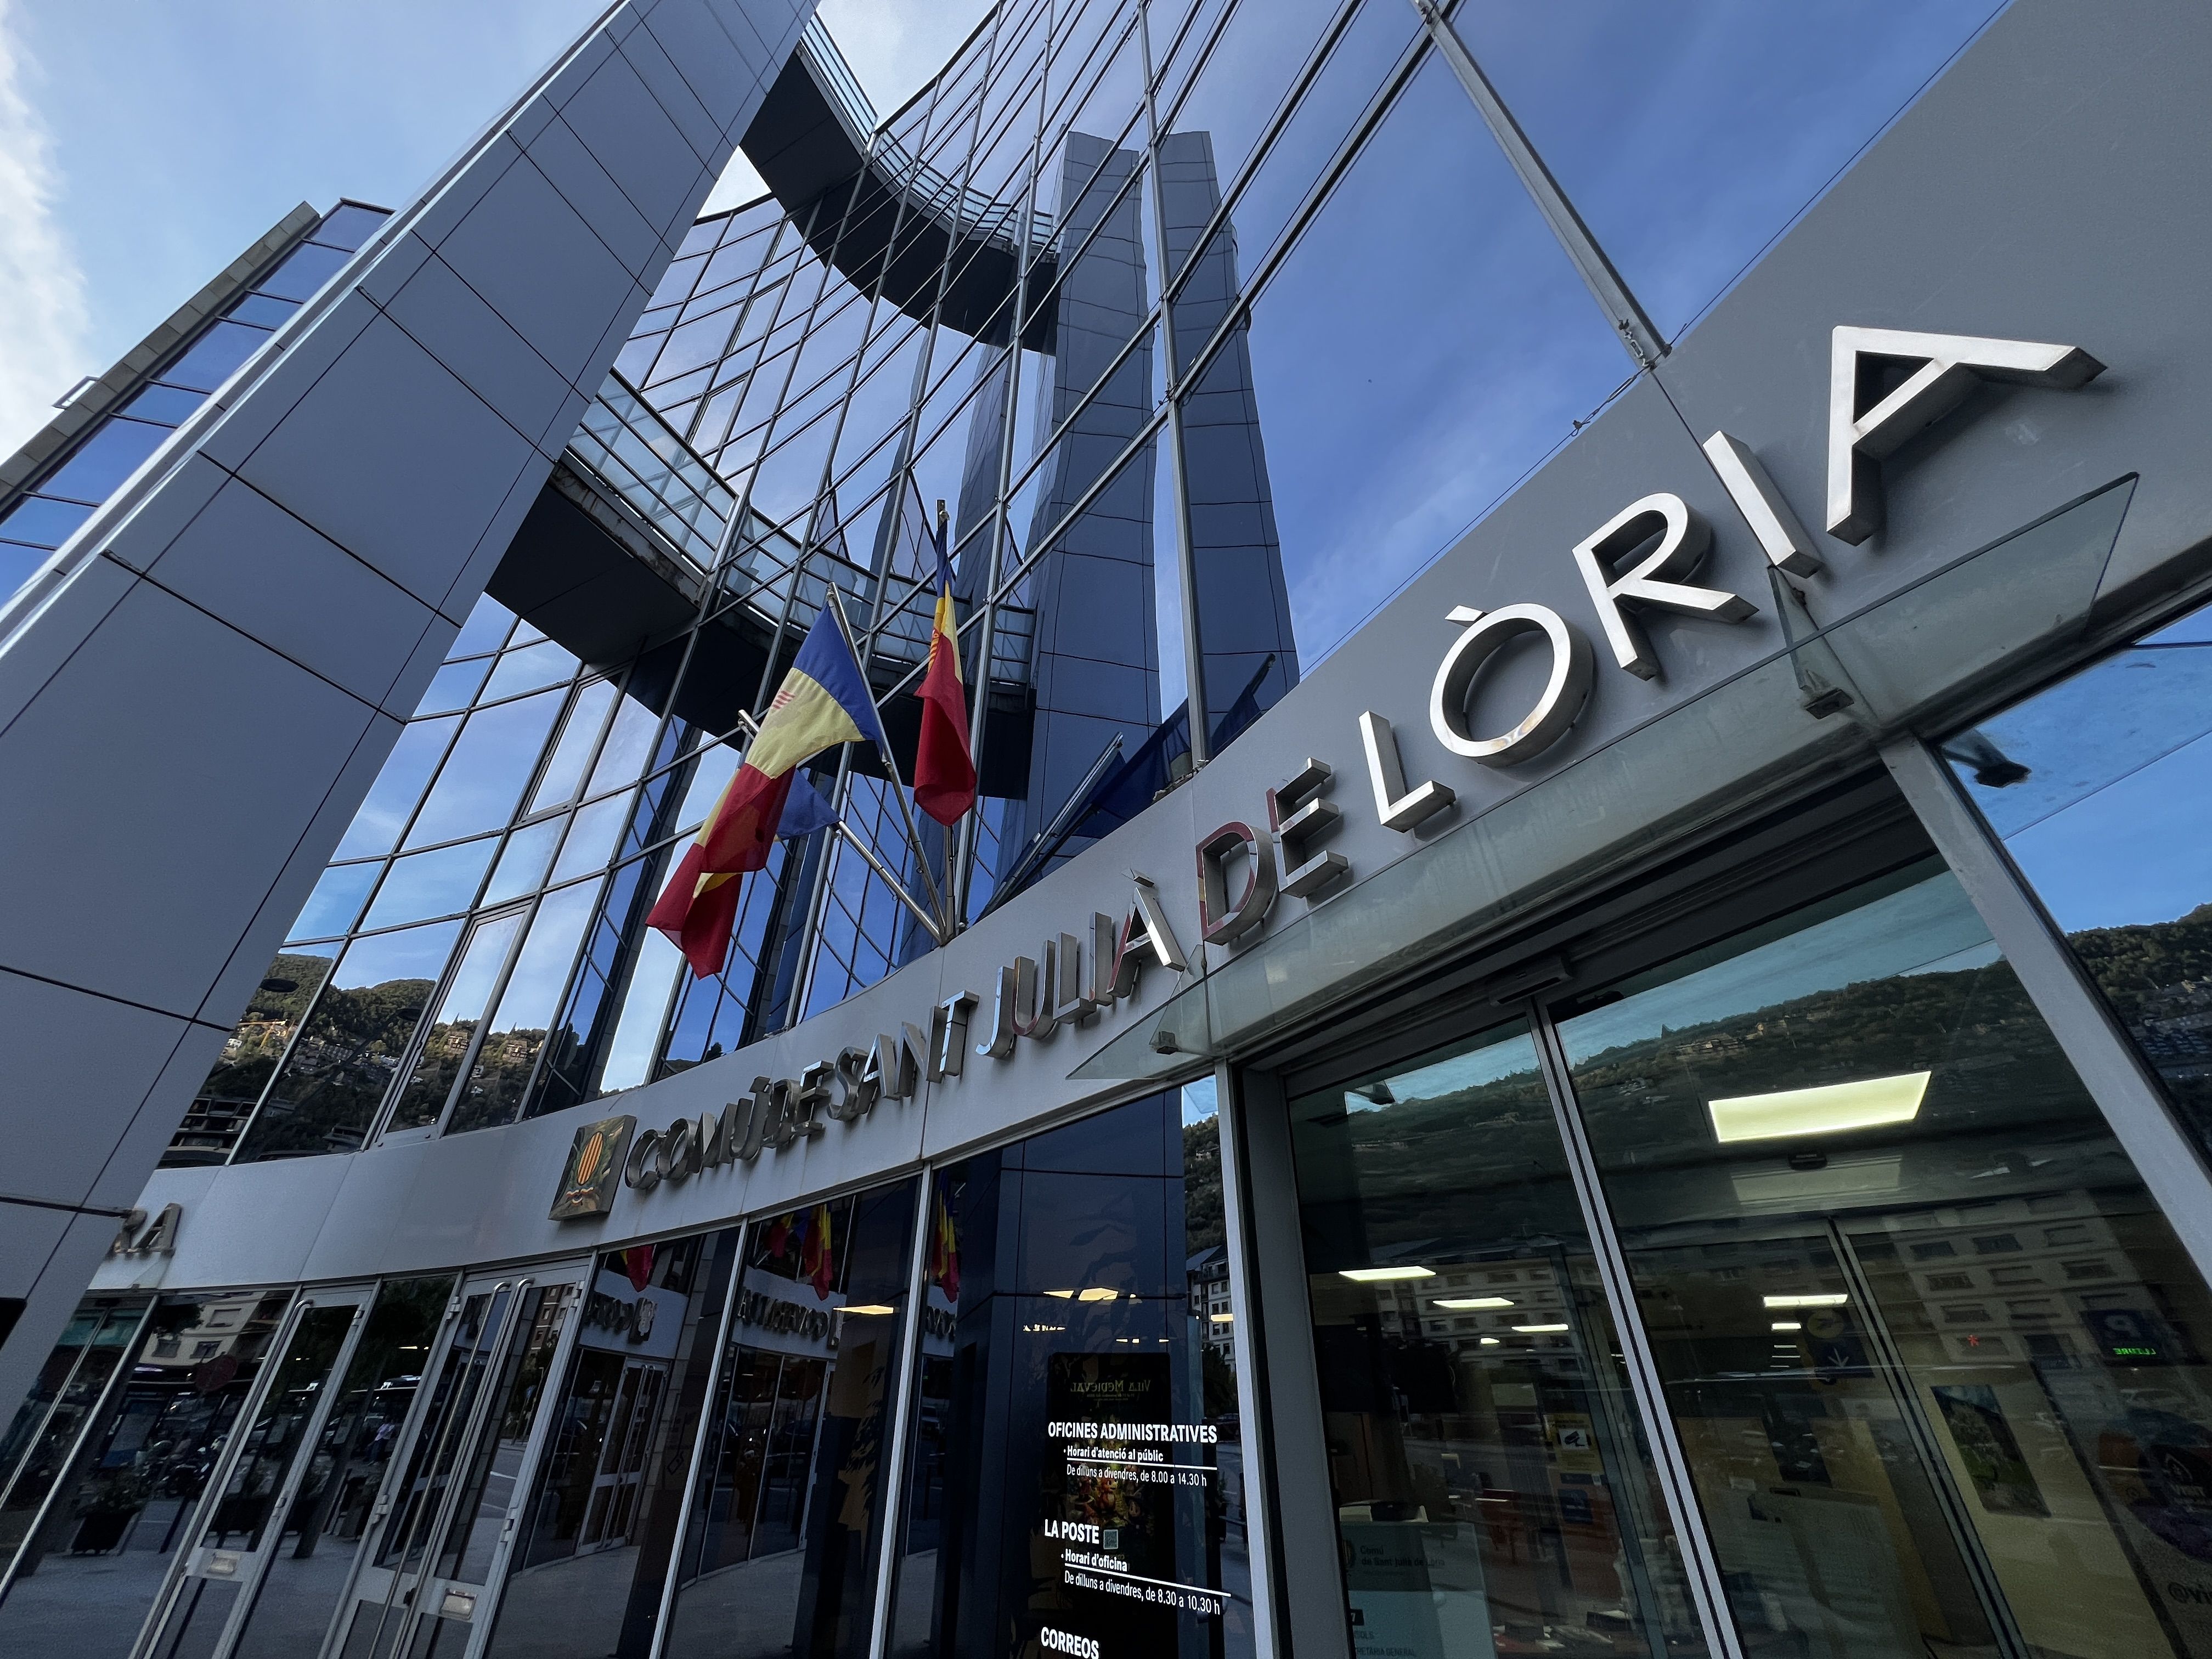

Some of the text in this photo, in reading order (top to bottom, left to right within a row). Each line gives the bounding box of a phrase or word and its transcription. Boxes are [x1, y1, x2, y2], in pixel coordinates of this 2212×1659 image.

[624, 325, 2109, 1189] COMÚ DE SANT JULIÀ DE LÒRIA
[1048, 1421, 1217, 1443] OFICINES ADMINISTRATIVES
[1067, 1444, 1090, 1457] Horari
[1128, 1449, 1136, 1460] al
[1137, 1448, 1164, 1463] públic
[1067, 1464, 1207, 1487] De dilluns a divendres, de 8.00 a 14.30 h
[1044, 1519, 1099, 1544] LA POSTE
[1065, 1548, 1090, 1565] Horari
[1064, 1570, 1220, 1615] De dilluns a divendres, de 8.30 a 10.30 h
[1041, 1626, 1099, 1659] CORREOS
